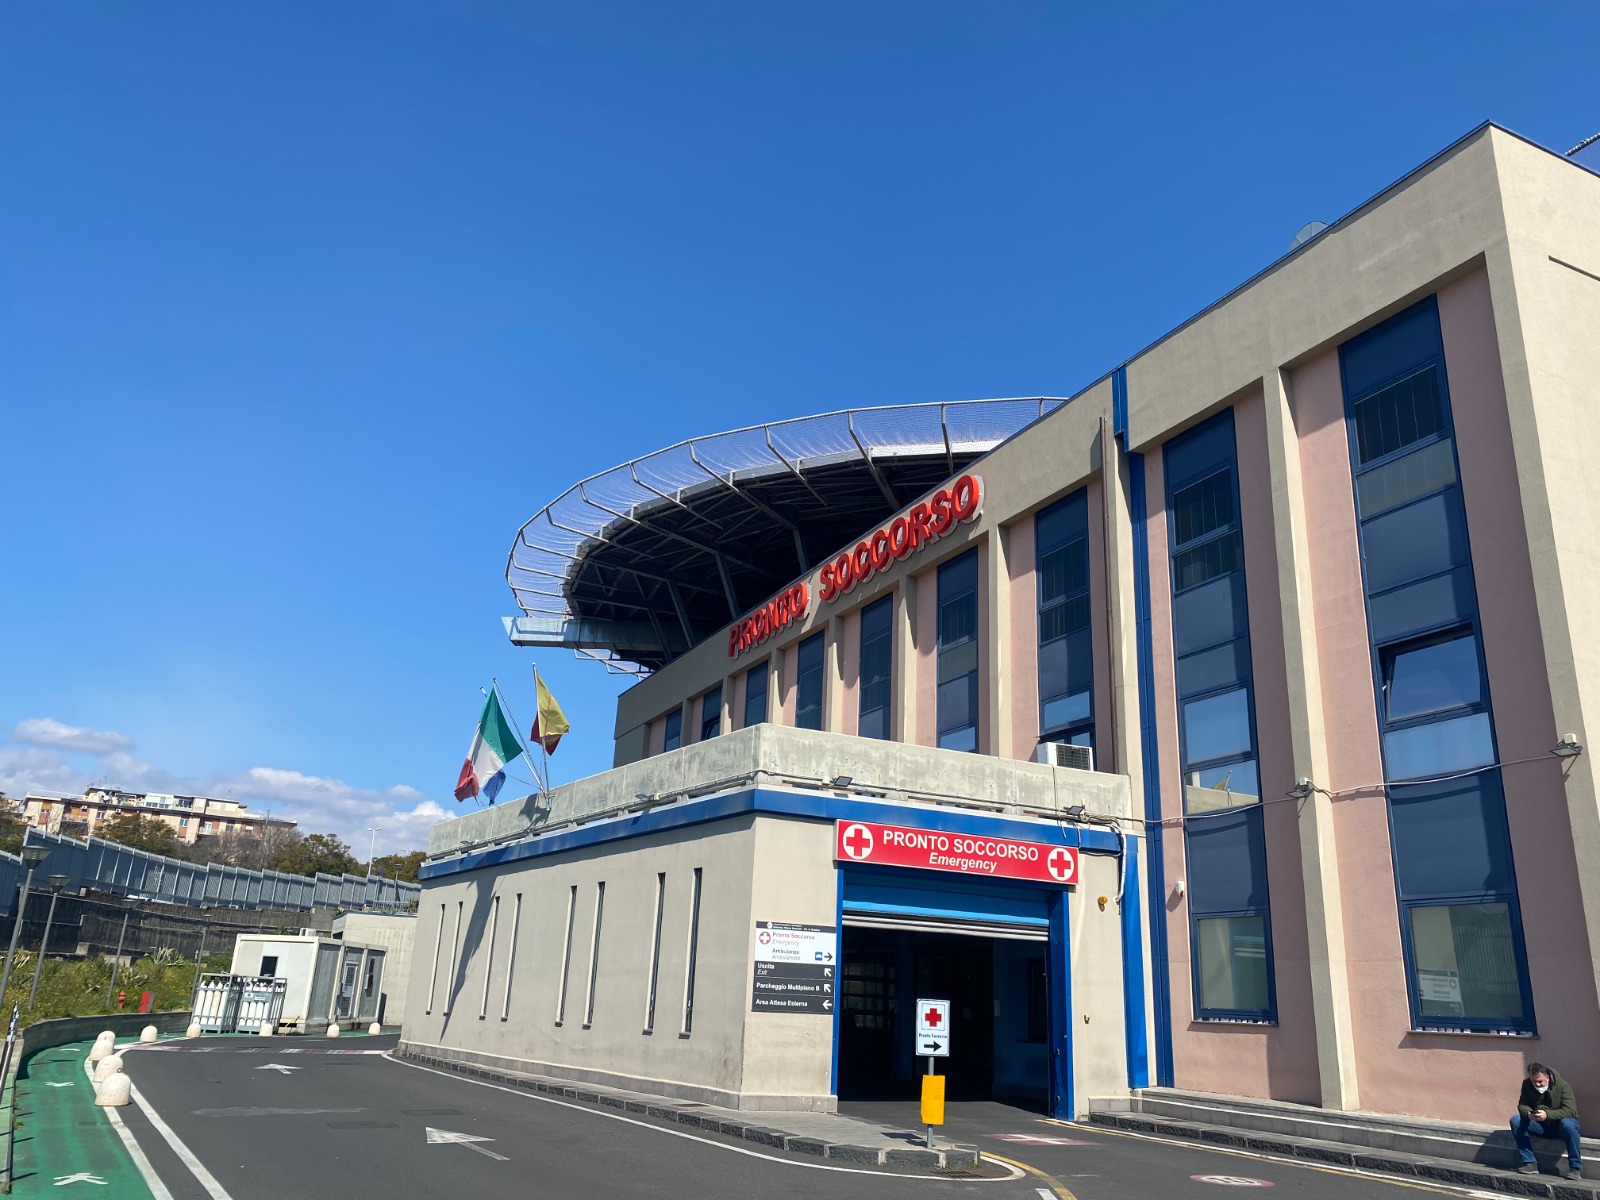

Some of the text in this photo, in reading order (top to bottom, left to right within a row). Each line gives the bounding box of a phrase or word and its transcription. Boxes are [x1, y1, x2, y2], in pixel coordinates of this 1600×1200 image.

[728, 475, 981, 658] PRONTO SOCCORSO
[883, 830, 1039, 861] PRONTO SOCCORSO
[928, 852, 997, 872] Emergency
[756, 982, 787, 990] Parcheggio
[787, 984, 815, 992] Multipiano
